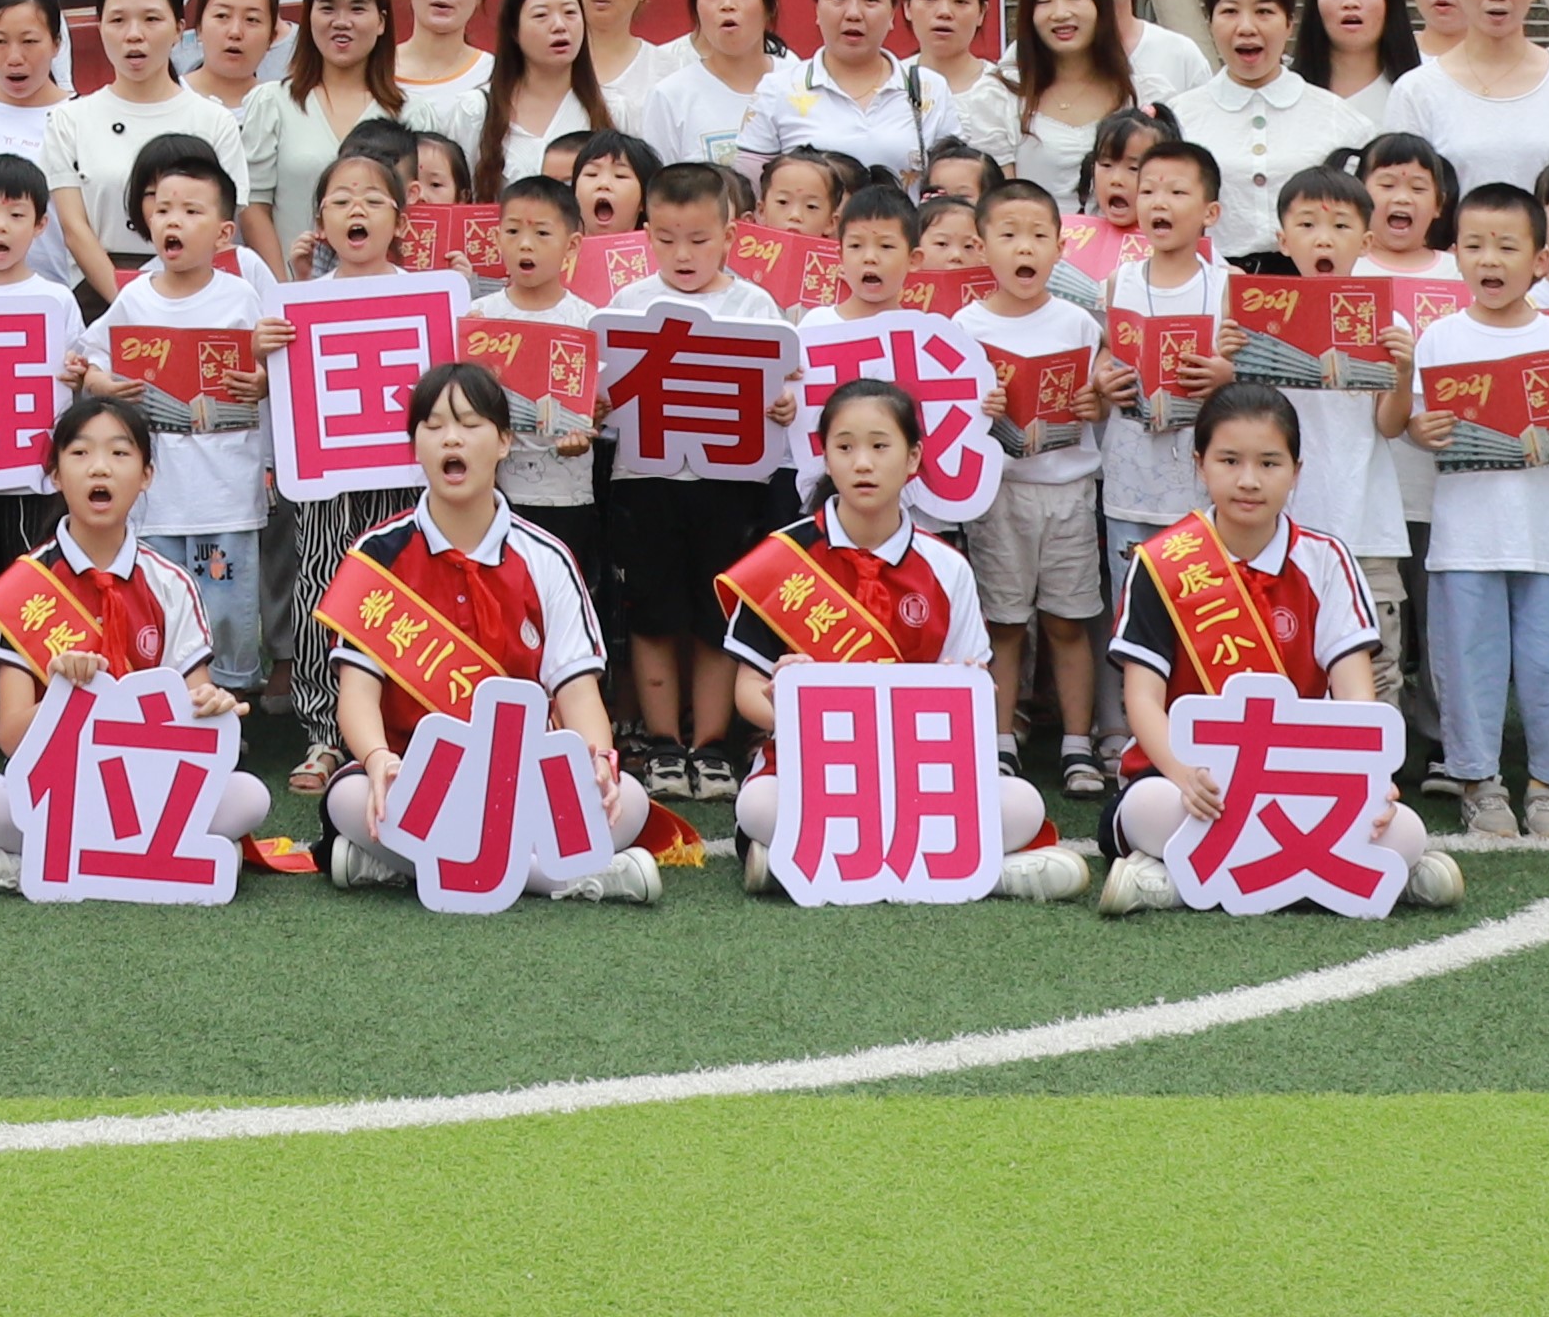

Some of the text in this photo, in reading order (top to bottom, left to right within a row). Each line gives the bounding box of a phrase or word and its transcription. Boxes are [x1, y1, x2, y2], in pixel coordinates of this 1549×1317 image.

[119, 337, 172, 371] 2021
[467, 331, 523, 366] 2021
[1242, 287, 1300, 322] 2021
[283, 292, 457, 479] 国
[606, 317, 781, 465] 有
[804, 330, 986, 502] 我
[1434, 373, 1493, 406] 2021
[360, 588, 483, 706] 娄底二小
[778, 572, 897, 664] 娄底二
[28, 687, 219, 885] 位
[398, 701, 592, 893] 小
[793, 686, 981, 882] 朋
[1188, 697, 1385, 899] 友
